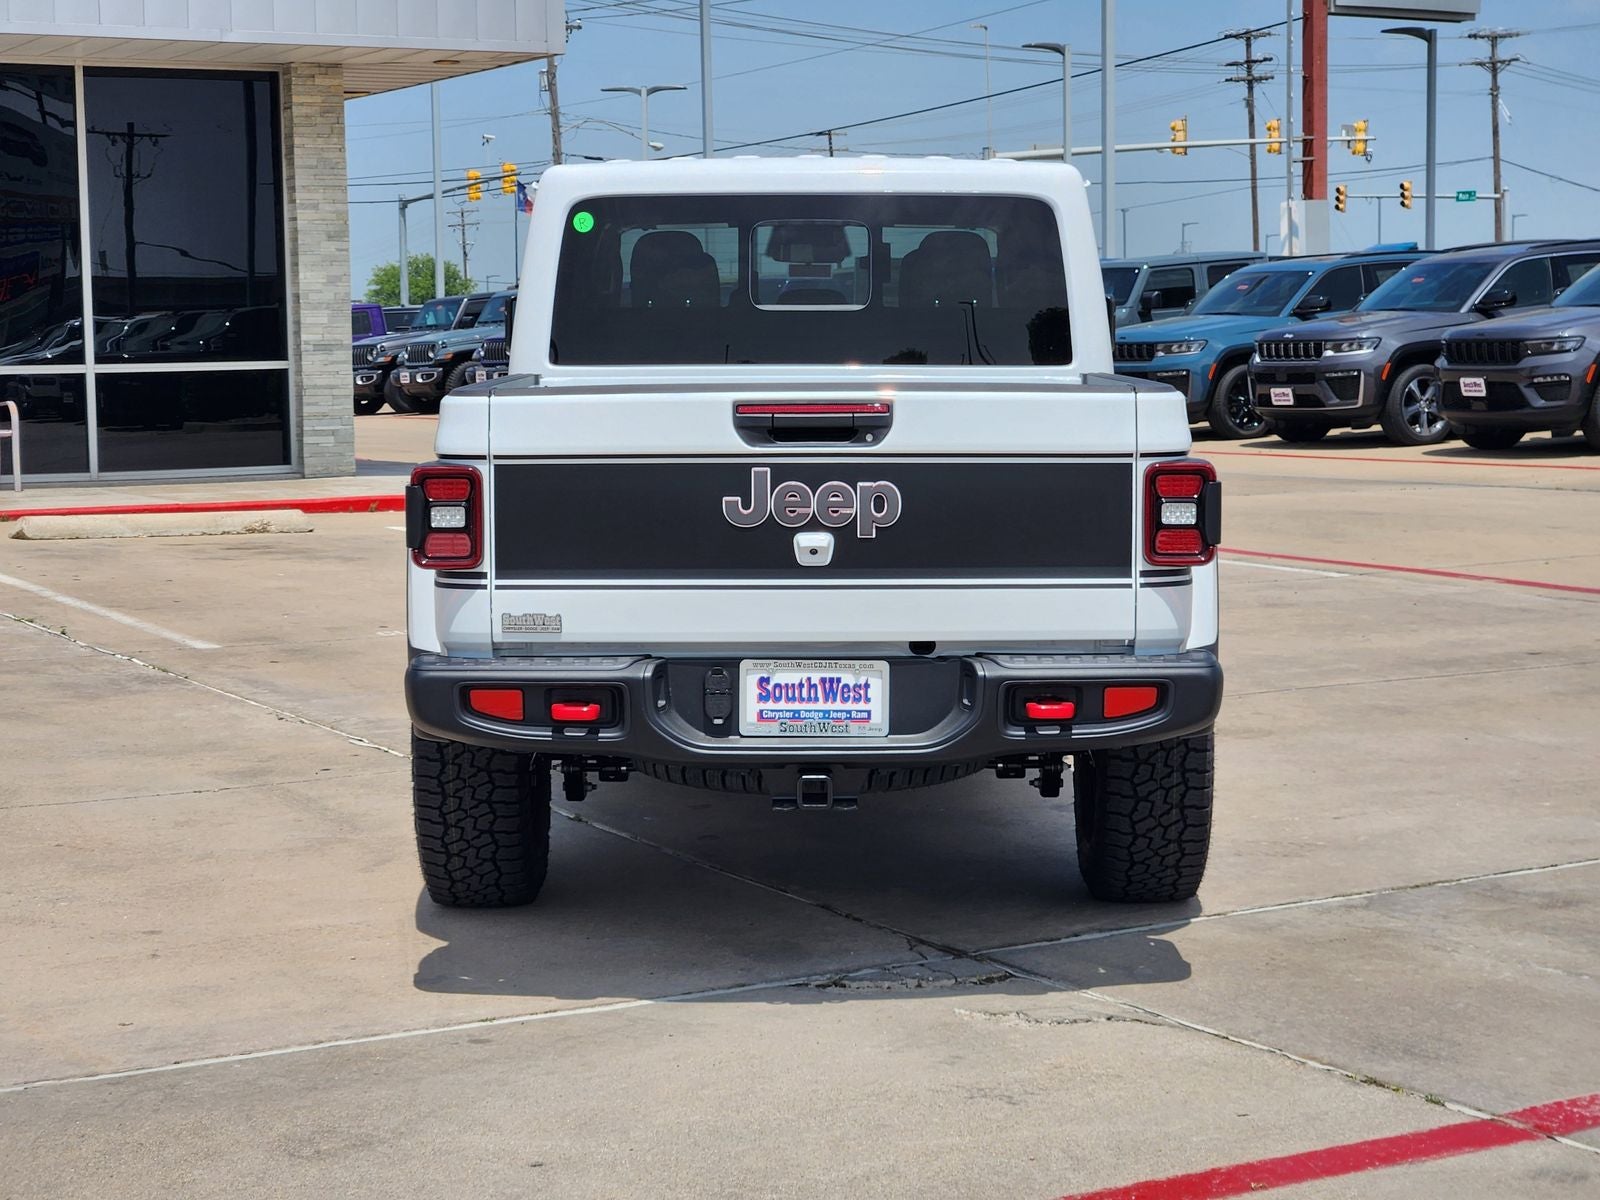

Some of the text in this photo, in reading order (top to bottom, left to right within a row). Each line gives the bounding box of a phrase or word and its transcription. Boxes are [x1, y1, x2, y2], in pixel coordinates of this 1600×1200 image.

[722, 467, 902, 538] Jeep
[502, 613, 561, 625] SouthWest
[757, 676, 871, 704] SouthWest
[762, 710, 868, 720] Chrysler Dodge Jeep Ram
[779, 722, 849, 734] SouthWest
